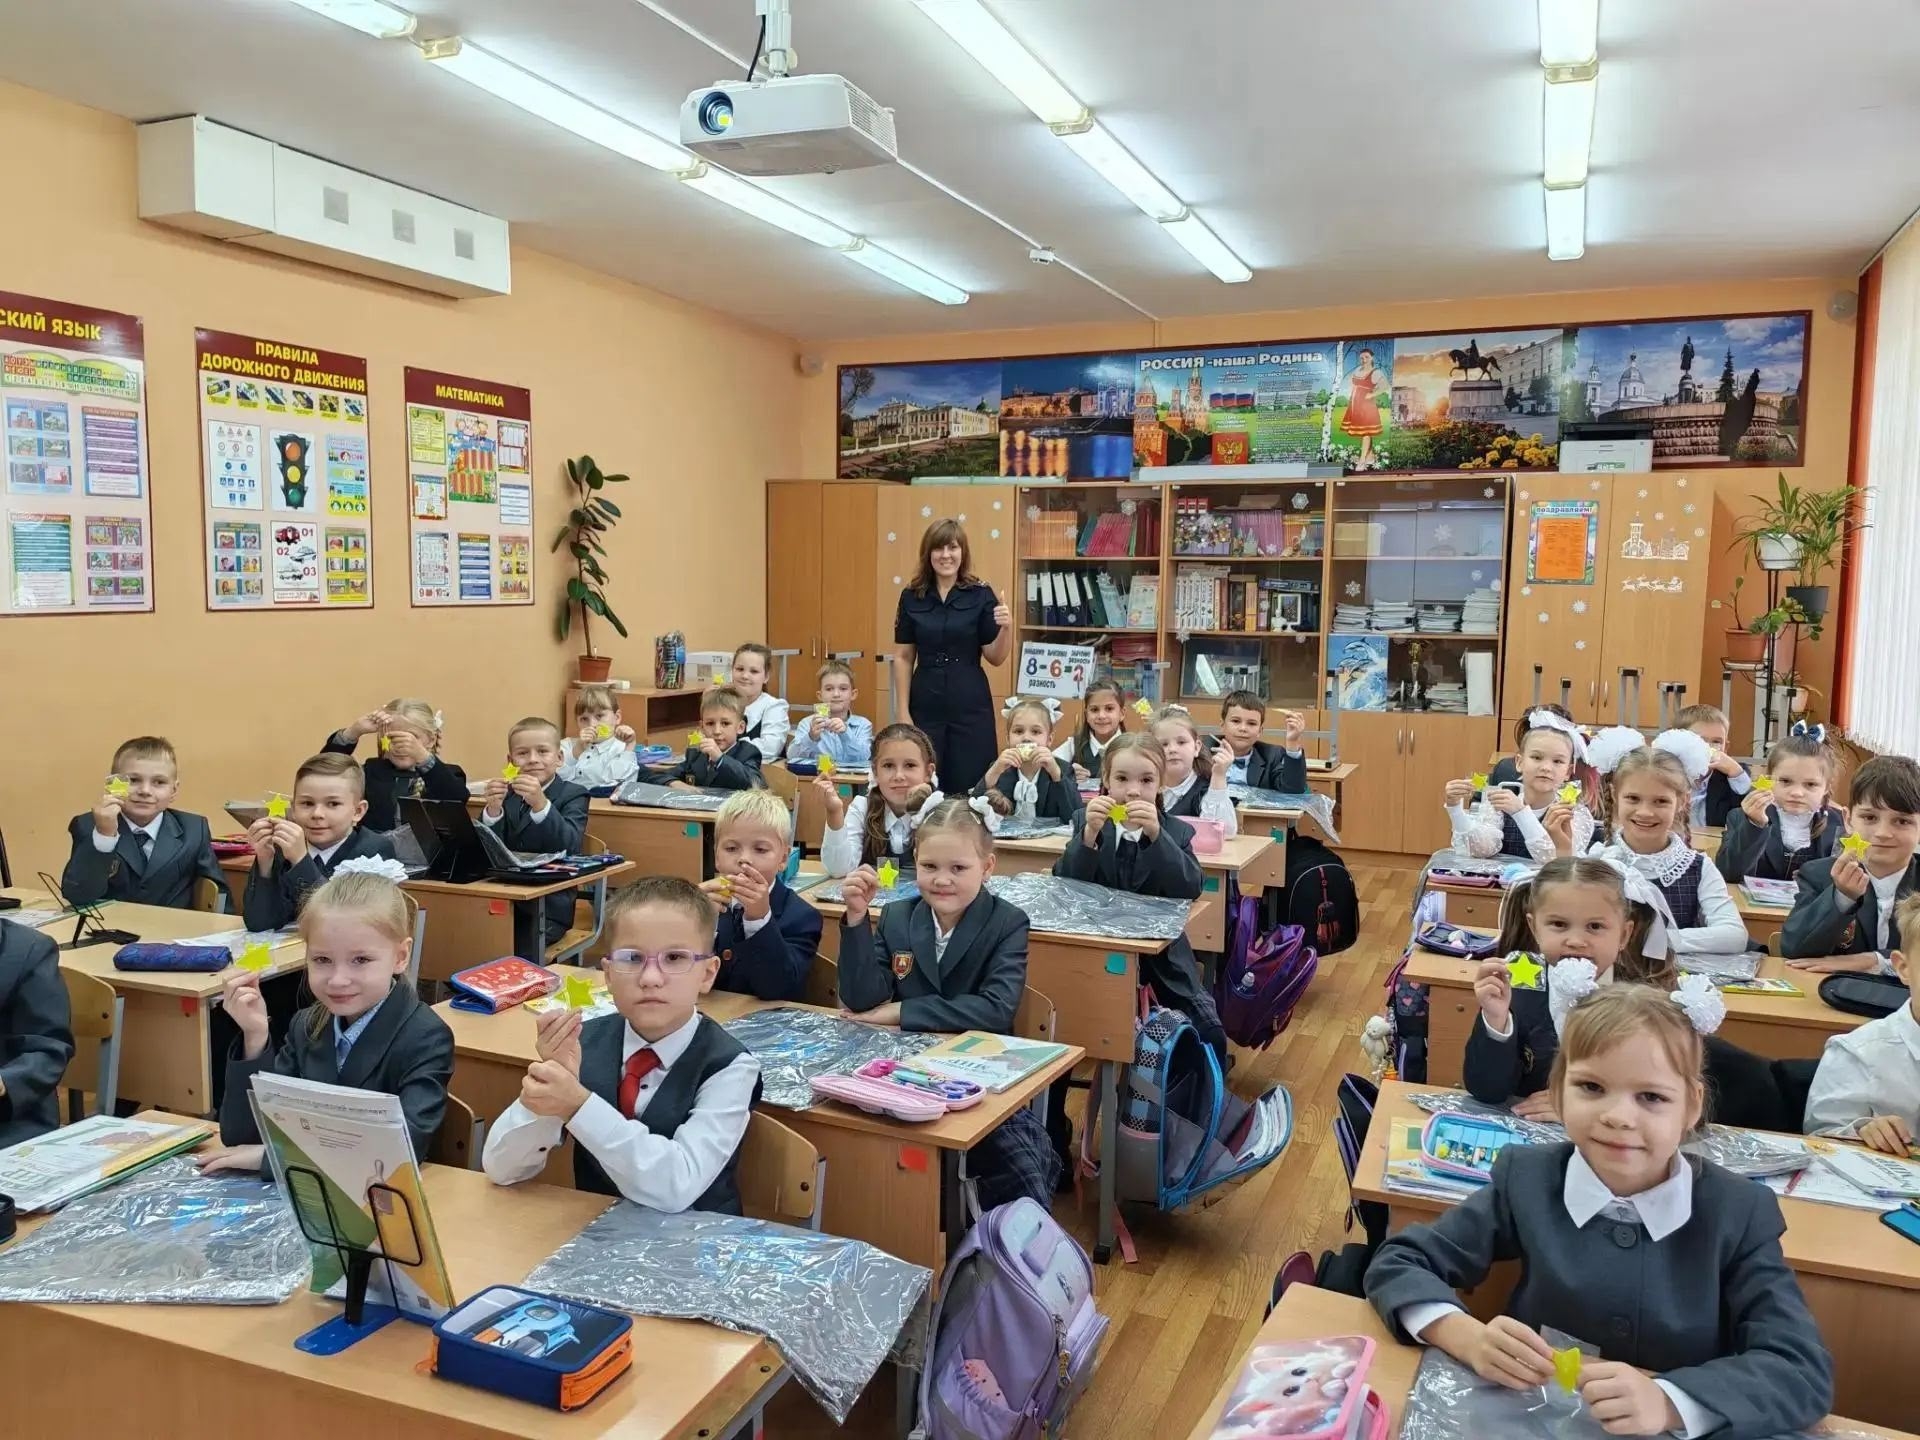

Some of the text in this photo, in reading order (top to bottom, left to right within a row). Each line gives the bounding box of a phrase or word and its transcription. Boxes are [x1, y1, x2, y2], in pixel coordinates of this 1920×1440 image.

[52, 318, 102, 340] ЯЗЫК
[255, 341, 319, 365] ПРАВИЛА
[1140, 357, 1204, 371] РОССИЯ
[1259, 352, 1322, 365] Родина
[201, 352, 365, 392] ДОРОЖНОГО ДВИЖЕНИЯ
[436, 385, 505, 406] МАТЕМАТИКА
[301, 528, 314, 537] 01
[276, 547, 290, 556] 02
[303, 567, 317, 576] 03
